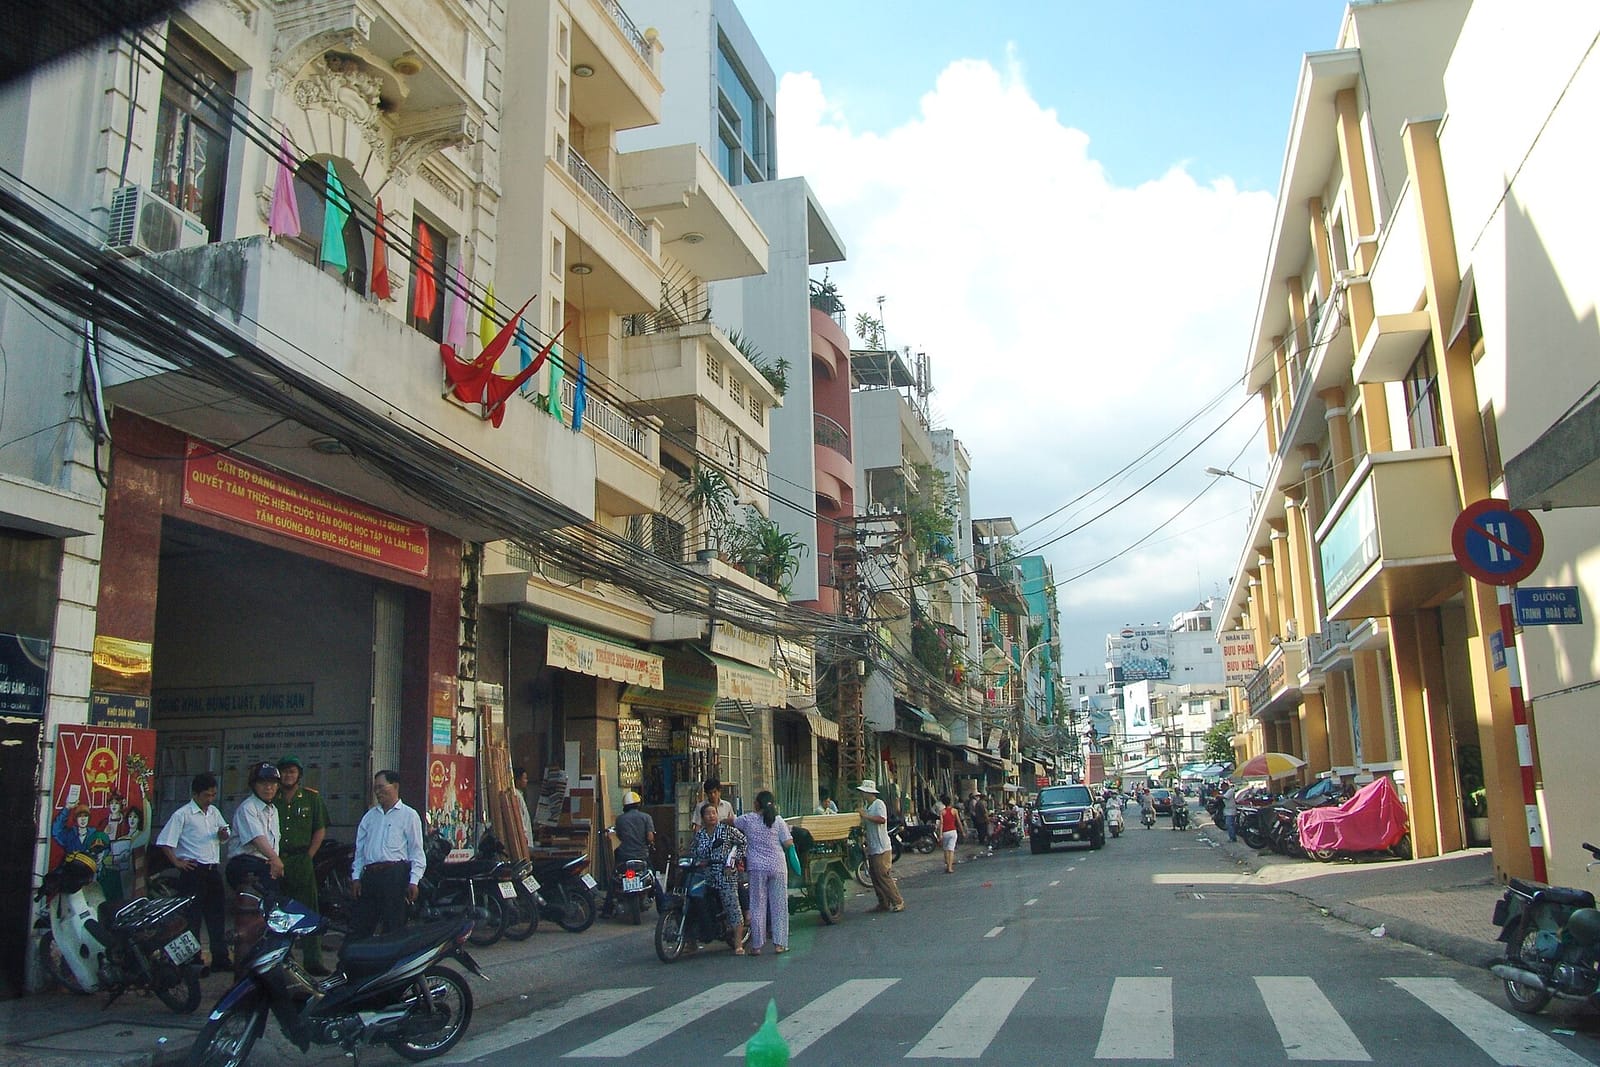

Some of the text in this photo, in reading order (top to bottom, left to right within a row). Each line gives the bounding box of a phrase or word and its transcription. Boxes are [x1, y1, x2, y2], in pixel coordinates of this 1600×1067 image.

[216, 459, 236, 476] CÁN
[238, 466, 250, 484] BỘ
[192, 469, 226, 490] QUYẾT
[227, 481, 245, 498] TÂM
[247, 489, 271, 507] THỰC
[272, 497, 291, 513] HIỆN
[293, 505, 315, 521] CUỘC
[316, 512, 332, 527] VẬN
[354, 524, 369, 538] HỌC
[408, 542, 424, 555] THEO
[305, 525, 321, 538] ĐẠO
[322, 529, 337, 543] ĐỨC
[338, 535, 349, 547] HỒ
[350, 540, 362, 551] CHÍ
[363, 546, 381, 557] MINH
[1532, 591, 1566, 601] ĐƯỜNG
